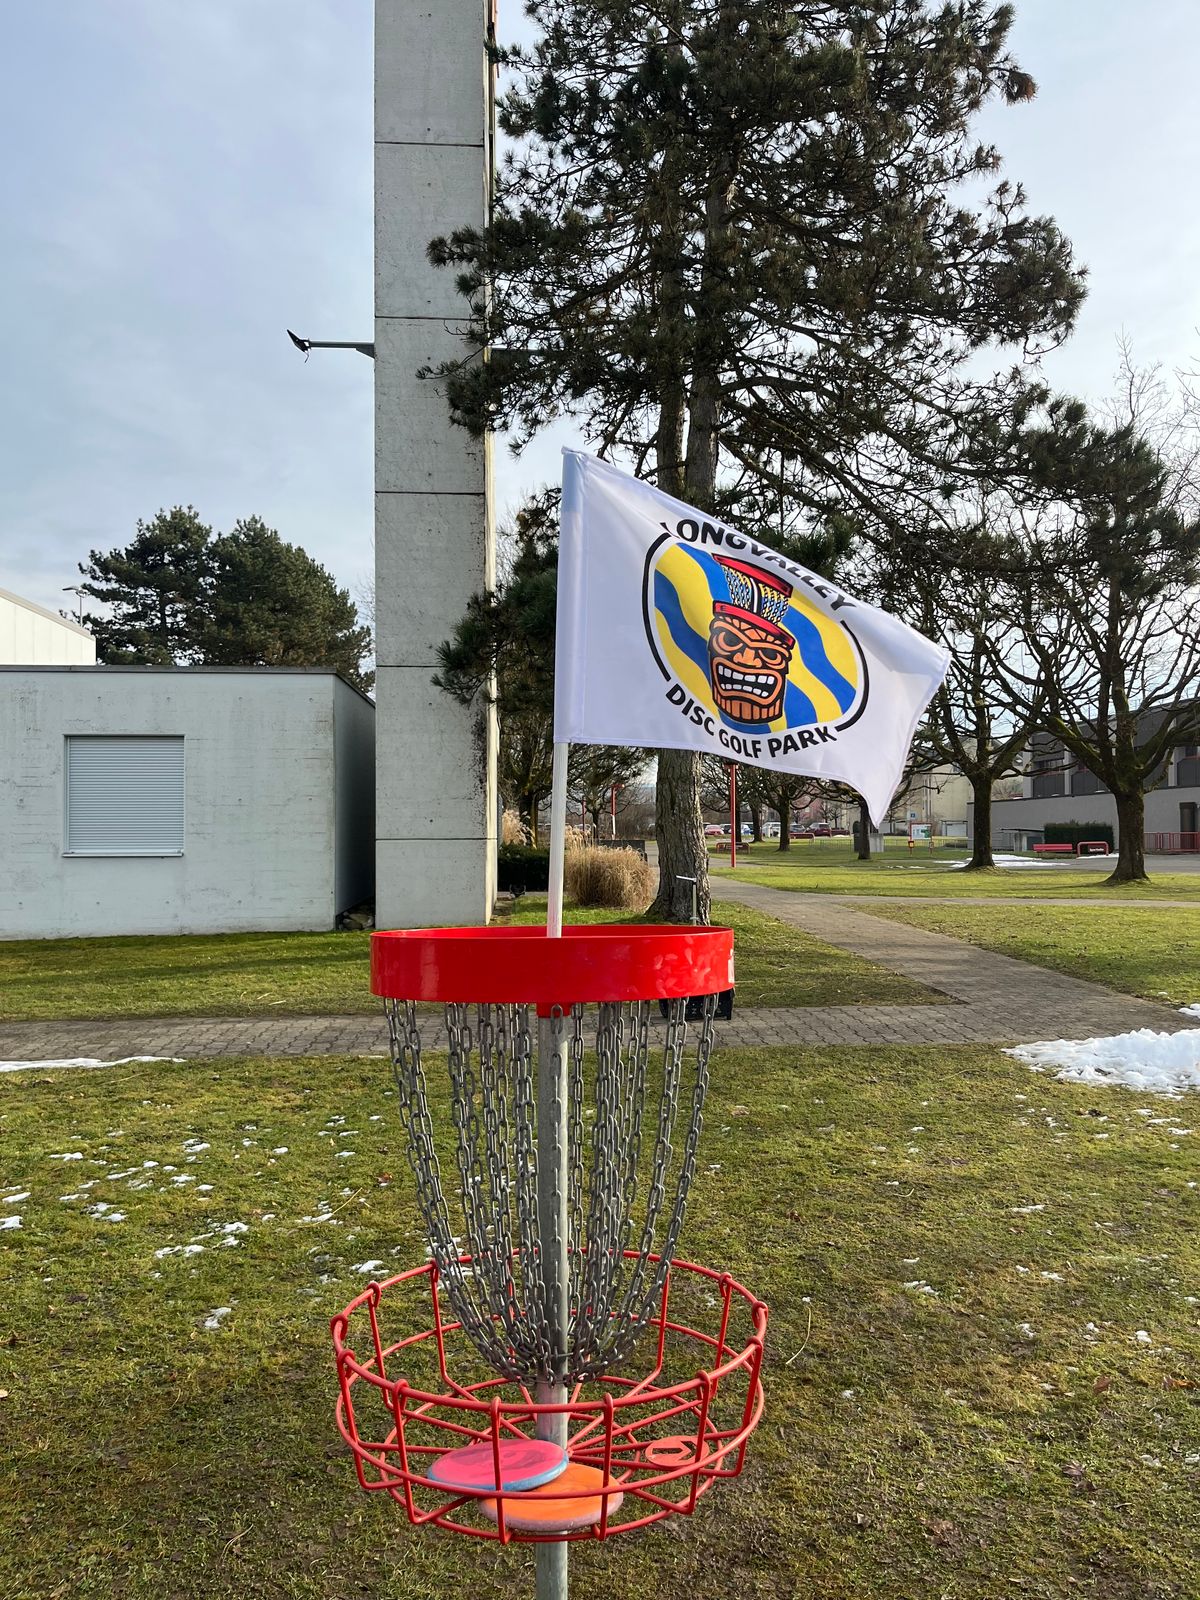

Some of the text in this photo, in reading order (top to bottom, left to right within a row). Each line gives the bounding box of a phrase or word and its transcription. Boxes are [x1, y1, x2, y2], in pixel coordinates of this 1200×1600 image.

[665, 683, 837, 758] DISC GOLF PARK
